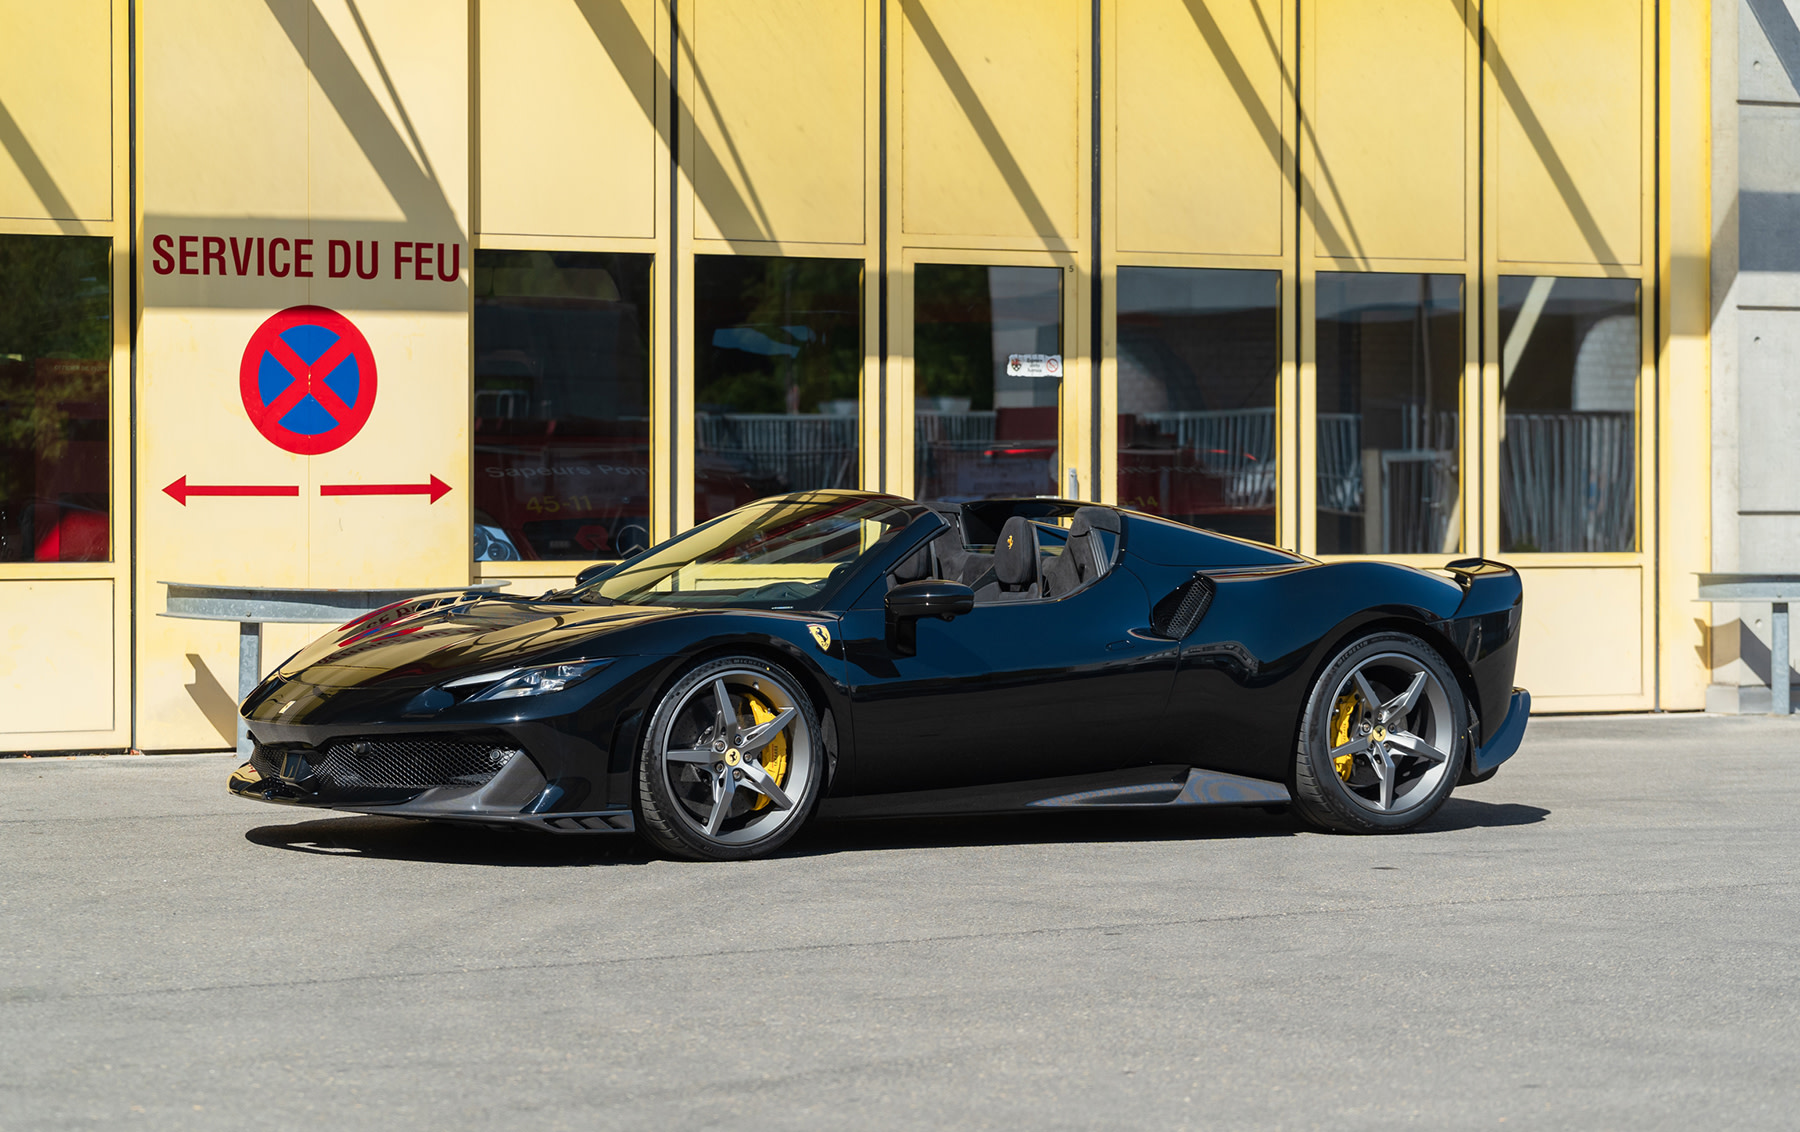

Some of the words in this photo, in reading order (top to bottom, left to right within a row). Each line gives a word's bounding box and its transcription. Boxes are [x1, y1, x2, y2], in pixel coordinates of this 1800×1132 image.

[152, 234, 314, 278] SERVICE
[328, 239, 379, 280] DU
[394, 241, 460, 283] FEU
[1069, 264, 1074, 273] 5
[486, 465, 591, 479] Sapeurs
[526, 495, 594, 514] 45-11
[1337, 640, 1369, 666] MICHELIN
